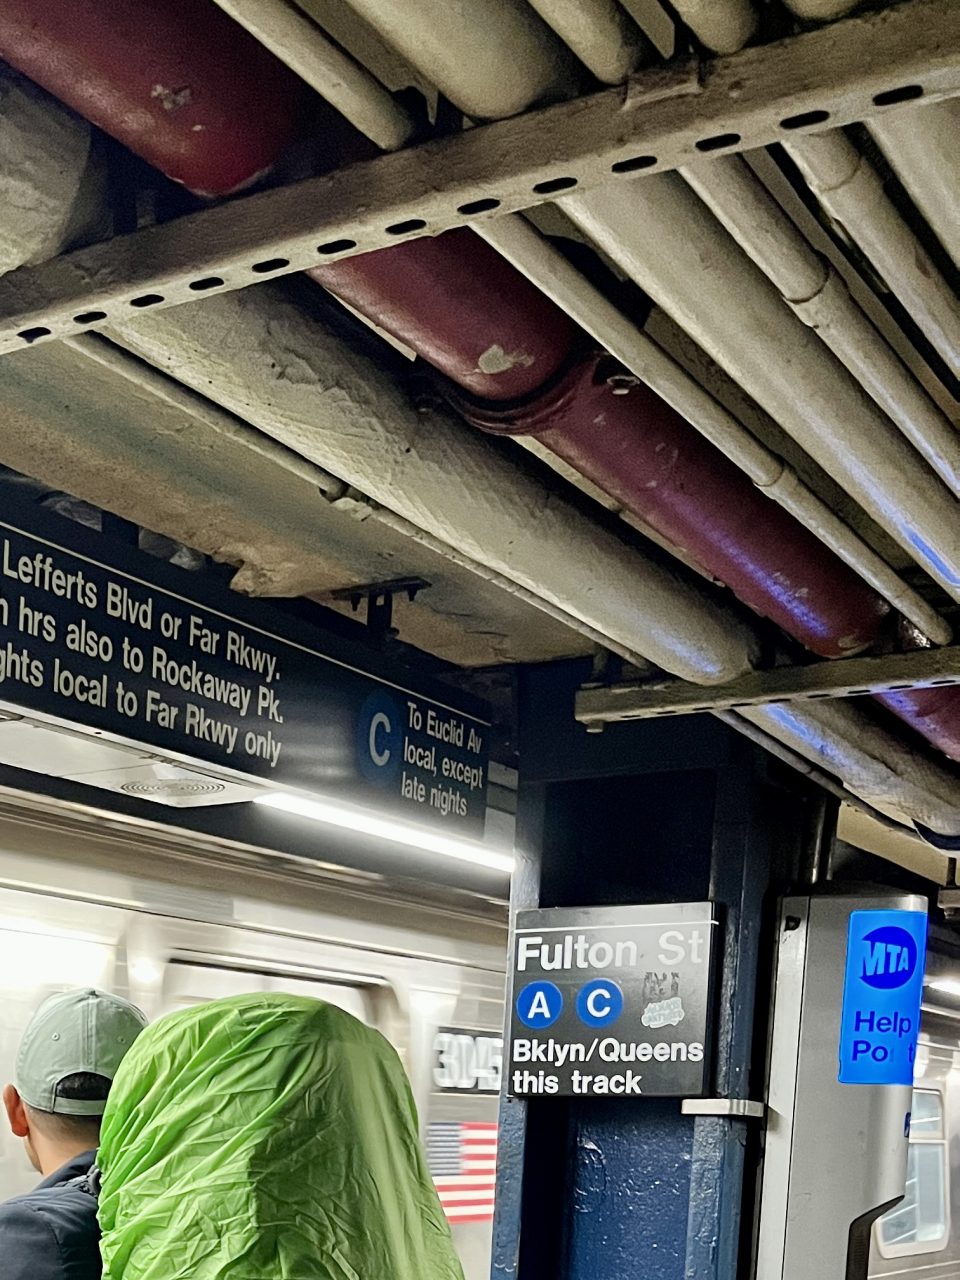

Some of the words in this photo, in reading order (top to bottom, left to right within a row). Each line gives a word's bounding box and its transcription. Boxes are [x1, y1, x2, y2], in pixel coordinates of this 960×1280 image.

[3, 539, 98, 609] Lefferts
[107, 582, 152, 632] Blvd
[160, 609, 181, 641] or
[189, 614, 220, 654] Far
[227, 630, 280, 684] Rkwy.
[19, 597, 56, 642] hrs
[66, 620, 113, 663] also
[122, 636, 144, 674] to
[152, 646, 251, 715] Rockaway
[257, 690, 284, 723] Pk.
[54, 658, 107, 709] local
[116, 681, 138, 718] to
[146, 690, 179, 732] Far
[185, 708, 238, 755] Rkwy
[245, 730, 281, 768] only
[408, 701, 422, 731] To
[426, 710, 464, 746] Euclid
[467, 727, 482, 754] Av
[369, 712, 391, 767] C
[404, 736, 437, 777] local,
[442, 756, 483, 791] except
[401, 771, 426, 803] late
[430, 784, 467, 817] nights
[517, 935, 637, 971] Fulton
[658, 930, 704, 965] St
[861, 940, 909, 978] MTA
[527, 991, 551, 1019] A
[586, 988, 611, 1018] C
[854, 1010, 912, 1038] Help
[512, 1037, 704, 1067] Bklyn/Queens
[851, 1040, 914, 1063] Pot
[512, 1069, 559, 1094] this
[571, 1069, 643, 1094] track
